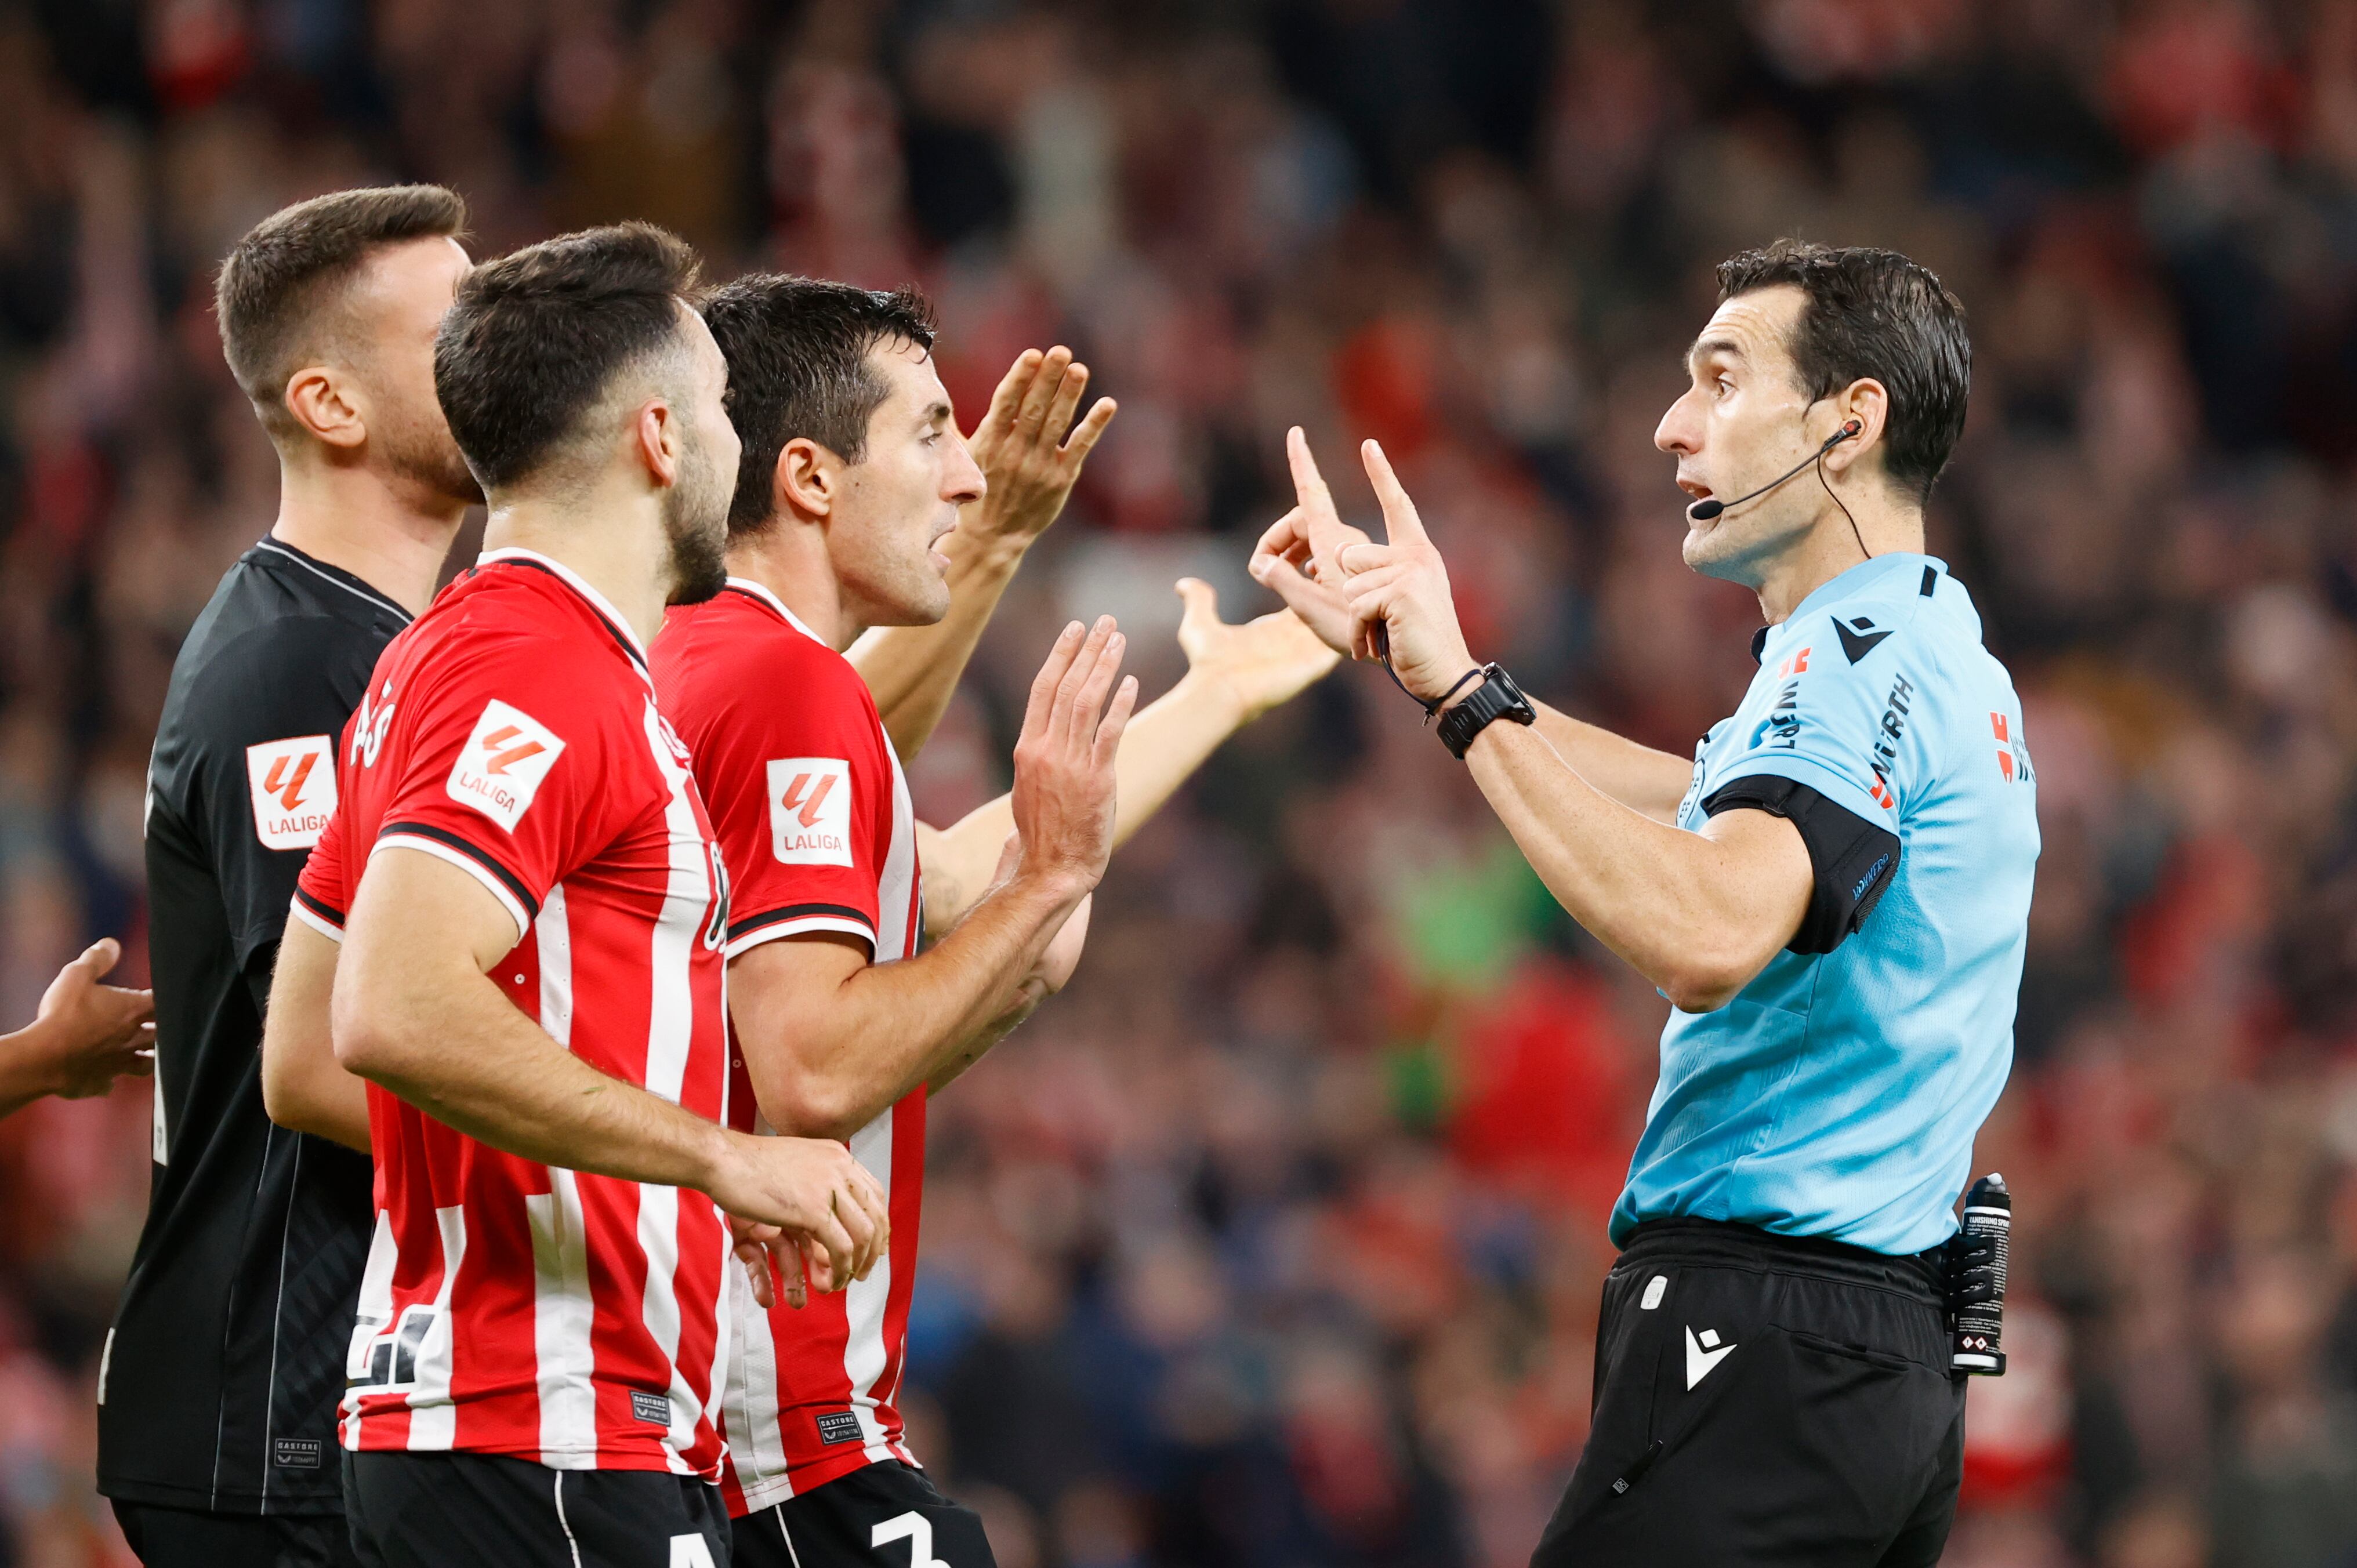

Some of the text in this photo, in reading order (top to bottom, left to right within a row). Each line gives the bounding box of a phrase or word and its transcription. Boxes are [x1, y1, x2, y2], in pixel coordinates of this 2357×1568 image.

[1870, 672, 1913, 785] WÜRTH
[460, 771, 515, 813] LALIGA
[268, 814, 329, 834] LALIGA
[784, 834, 842, 851] LALIGA
[1969, 1216, 1997, 1226] VANISHING
[634, 1395, 666, 1407] CASTORE
[821, 1416, 854, 1427] CASTORE
[278, 1442, 318, 1451] CASTORE
